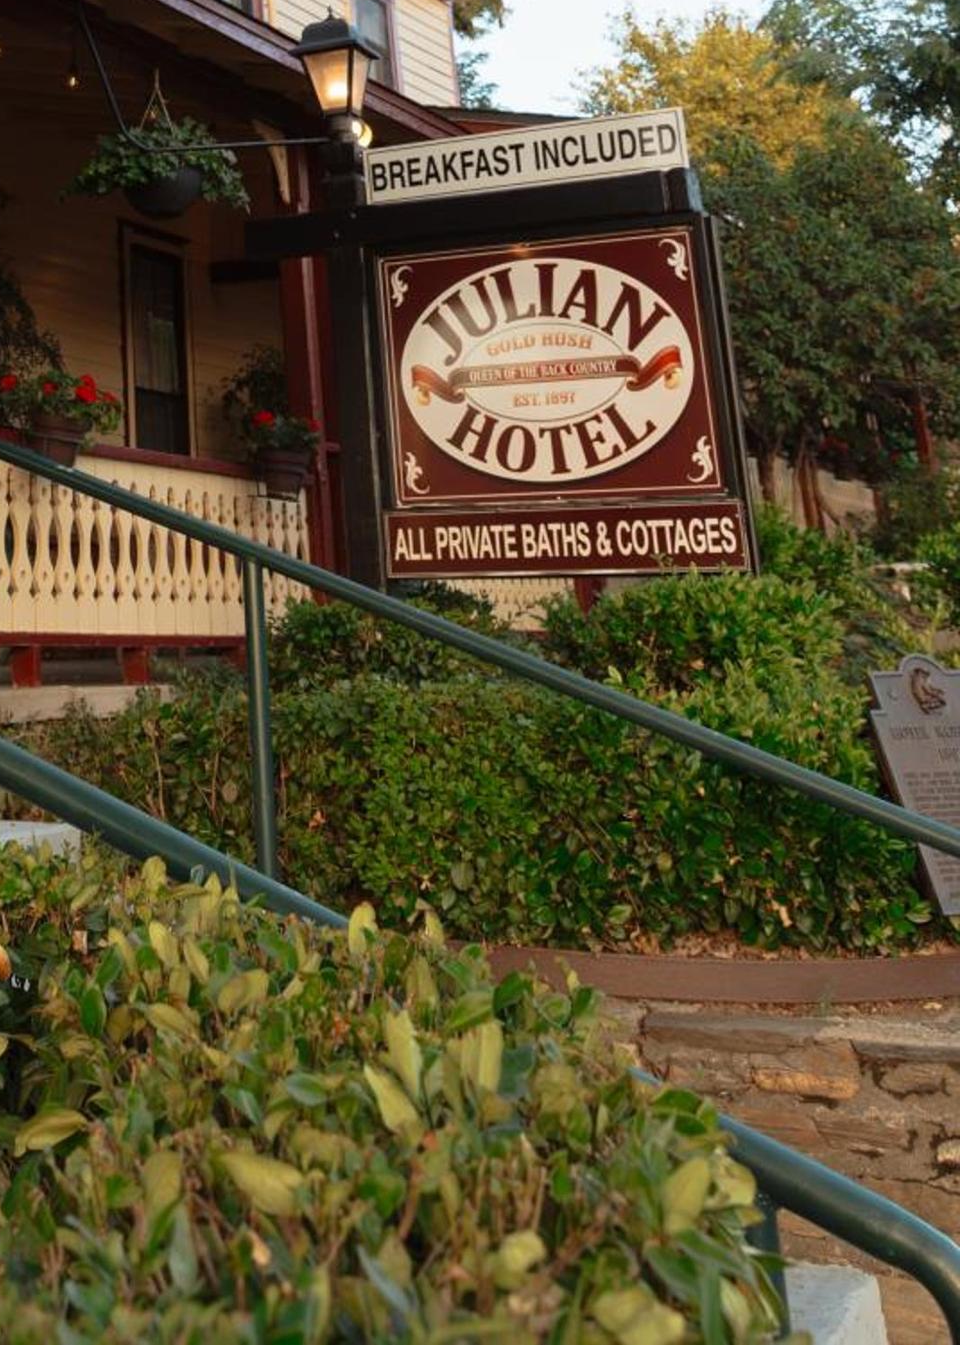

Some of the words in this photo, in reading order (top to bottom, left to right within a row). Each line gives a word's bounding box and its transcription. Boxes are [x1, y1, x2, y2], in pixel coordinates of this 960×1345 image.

[371, 143, 525, 192] BREAKFAST
[535, 123, 677, 171] INCLUDED
[422, 263, 672, 365] JULIAN
[487, 336, 536, 356] GOLD
[469, 369, 503, 383] QUEEN
[504, 368, 516, 380] OF
[519, 366, 539, 379] THE
[540, 364, 567, 377] BACK
[570, 359, 617, 376] COUNTRY
[513, 393, 542, 408] EST.
[446, 402, 657, 475] HOTEL
[395, 526, 433, 561] ALL
[436, 523, 519, 560] PRIVATE
[521, 521, 591, 558] BATHS
[595, 523, 614, 557] &
[615, 517, 737, 557] COTTAGES
